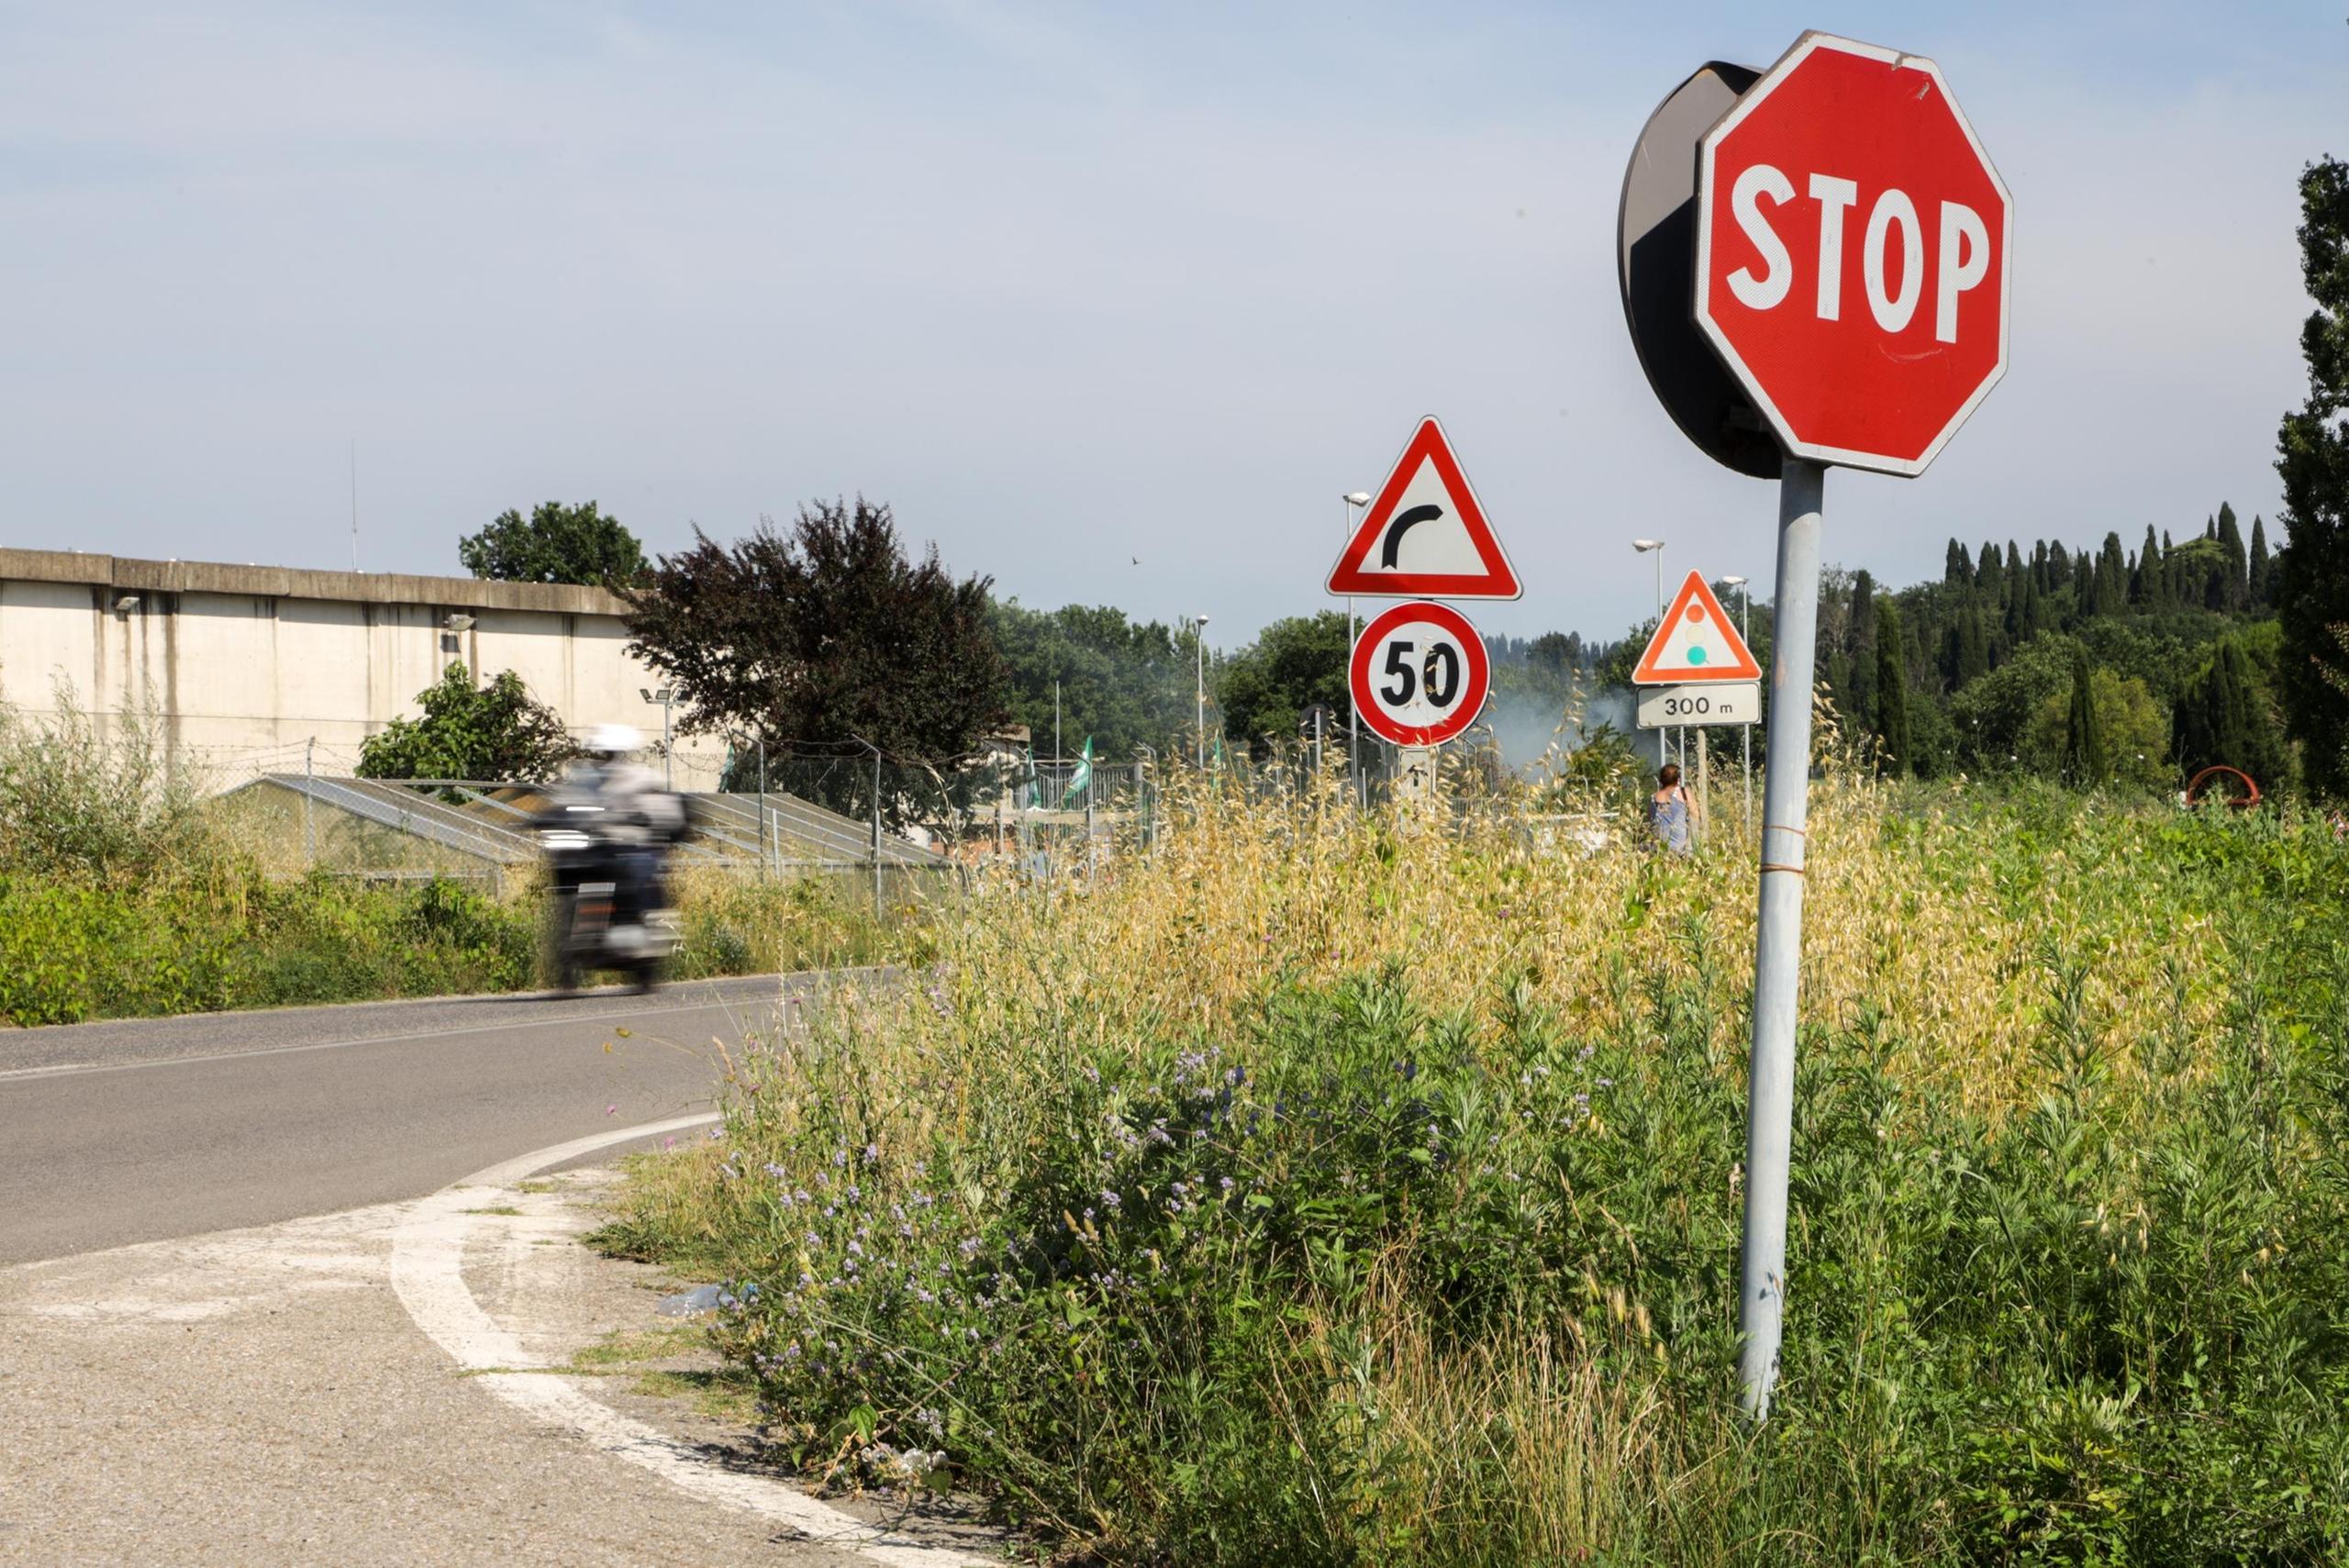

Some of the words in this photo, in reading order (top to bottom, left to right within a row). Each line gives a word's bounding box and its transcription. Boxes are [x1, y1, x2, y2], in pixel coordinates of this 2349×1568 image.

[1726, 163, 1990, 344] STOP
[1380, 641, 1460, 708] 50
[1664, 697, 1709, 716] 300
[1720, 704, 1732, 714] m
